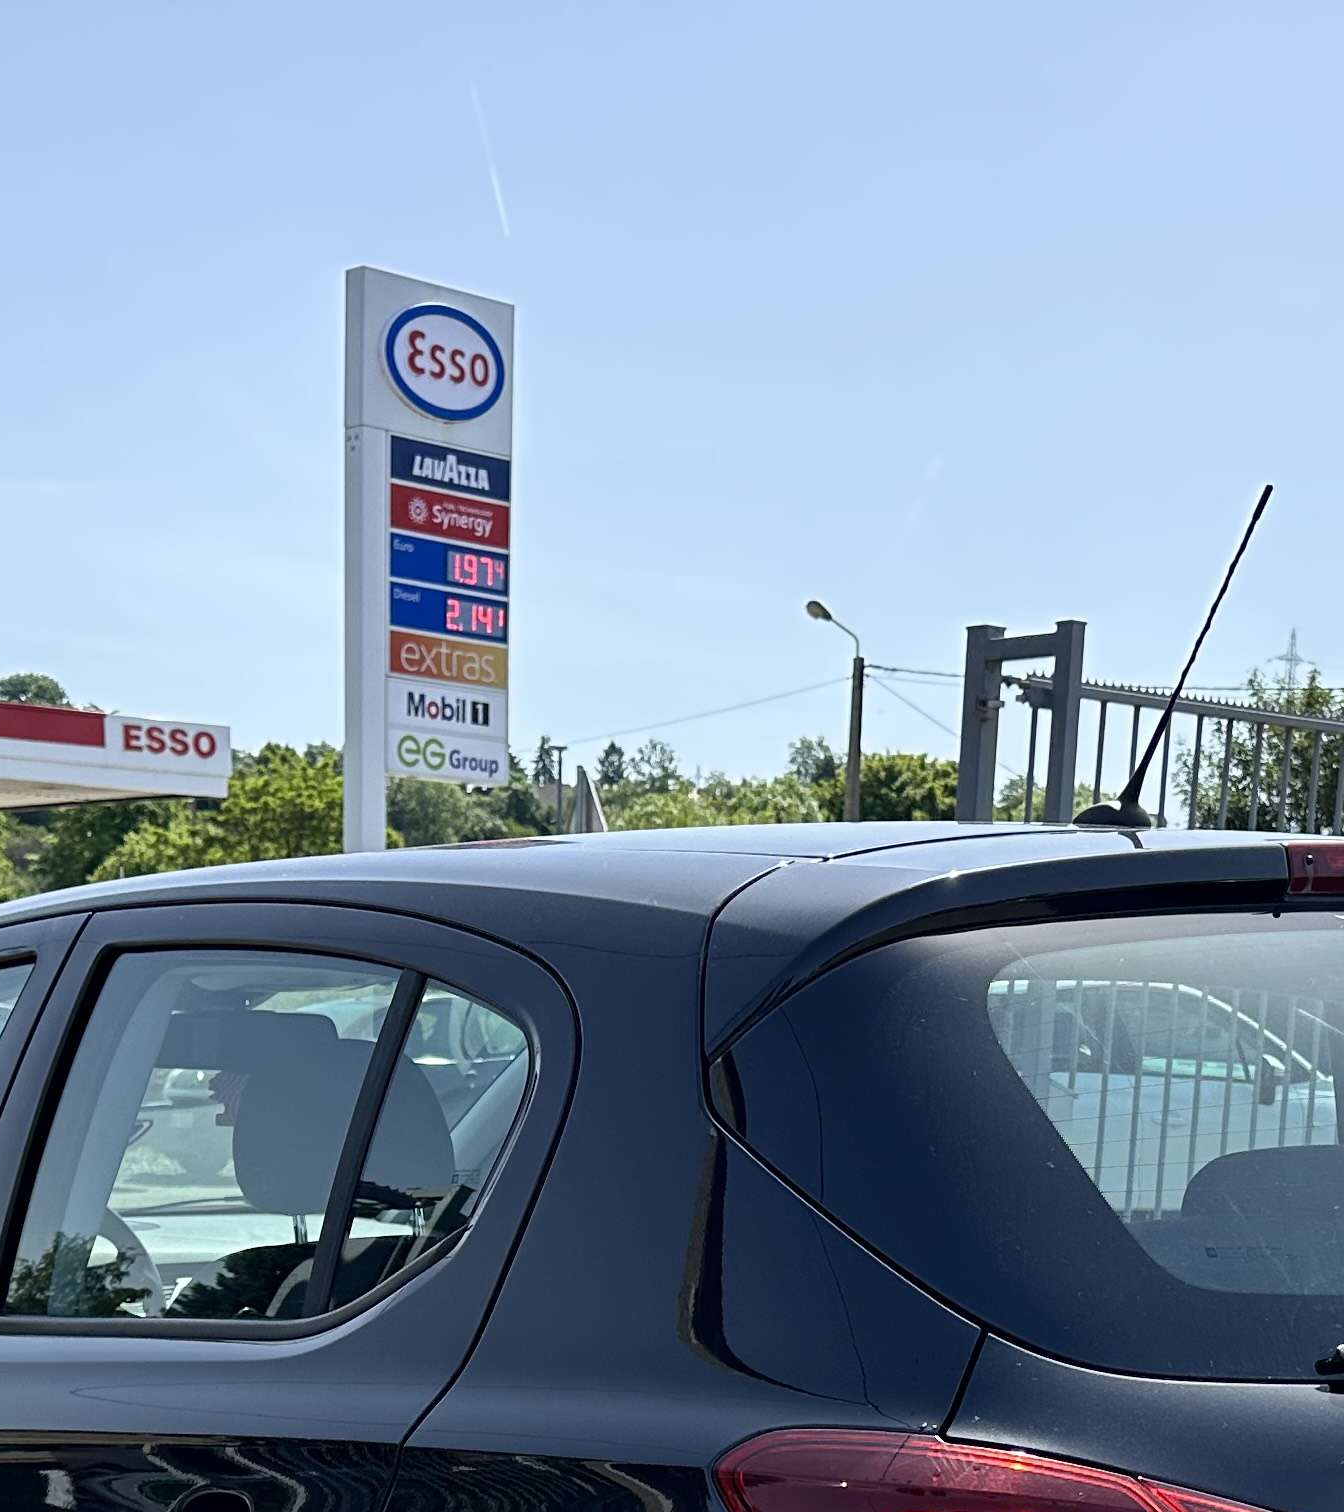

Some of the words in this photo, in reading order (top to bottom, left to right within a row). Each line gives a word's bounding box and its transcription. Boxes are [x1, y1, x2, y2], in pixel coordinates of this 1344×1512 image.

[412, 453, 490, 491] LAVAZZA
[432, 504, 493, 538] Synergy
[400, 640, 496, 682] extras
[407, 692, 466, 724] Mobil
[123, 725, 216, 759] ESSO
[449, 750, 499, 777] Group
